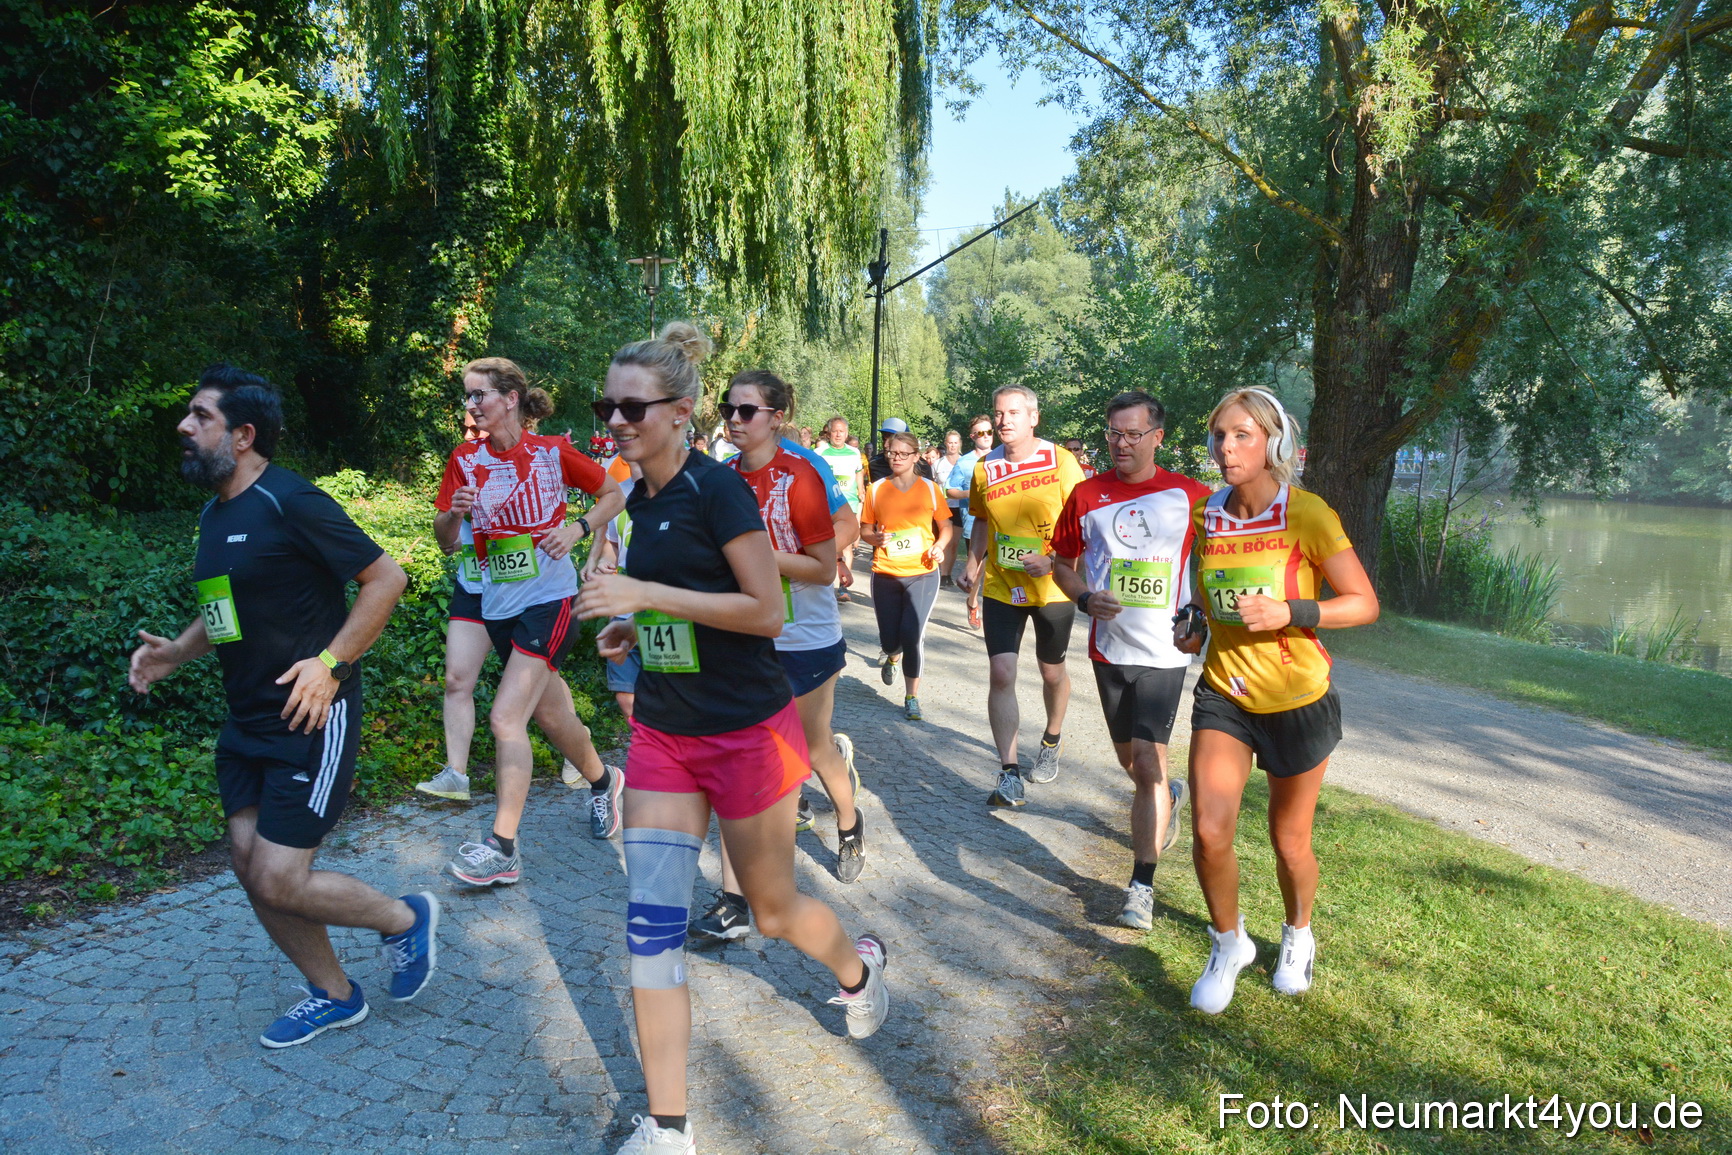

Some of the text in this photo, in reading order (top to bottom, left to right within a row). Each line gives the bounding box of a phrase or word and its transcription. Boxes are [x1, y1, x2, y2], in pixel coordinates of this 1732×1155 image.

[987, 474, 1059, 502] MAX BÖGL
[896, 539, 911, 550] 92
[1001, 546, 1032, 561] 126
[1203, 537, 1289, 556] MAX BÖGL
[491, 551, 529, 571] 1852
[1118, 575, 1163, 595] 1566
[643, 625, 676, 652] 741
